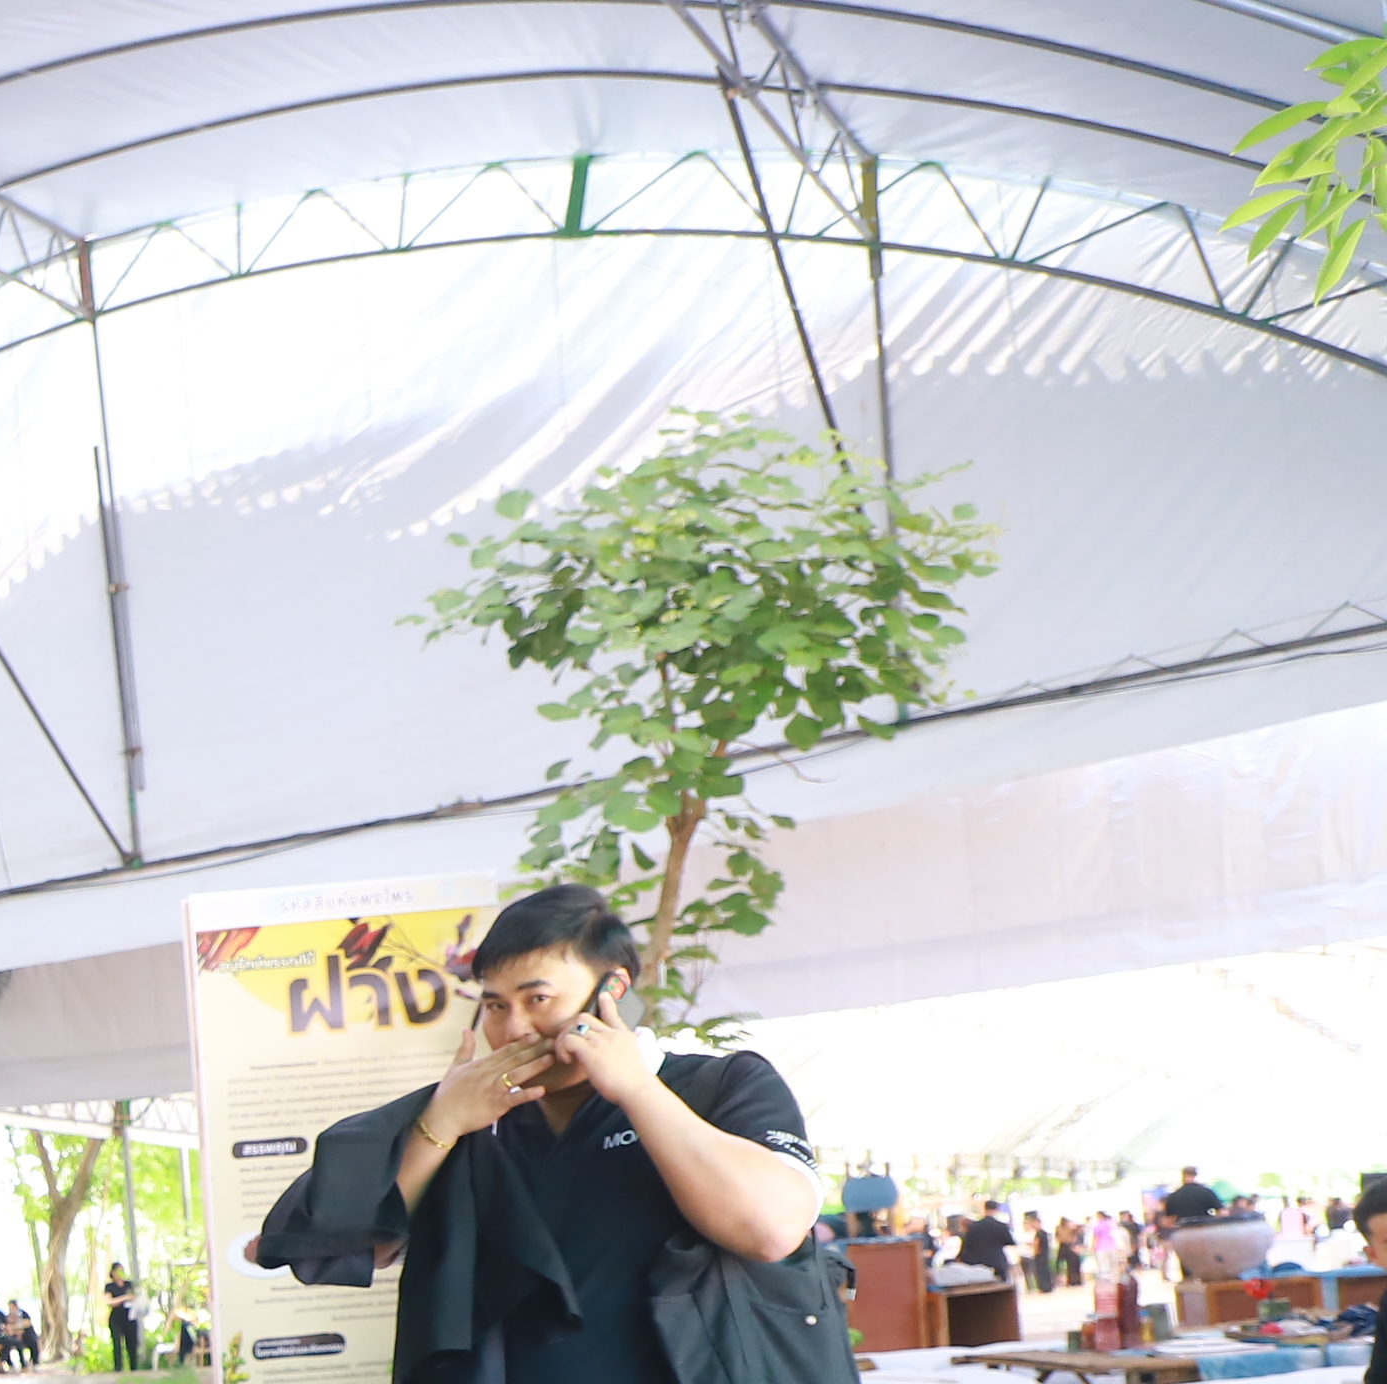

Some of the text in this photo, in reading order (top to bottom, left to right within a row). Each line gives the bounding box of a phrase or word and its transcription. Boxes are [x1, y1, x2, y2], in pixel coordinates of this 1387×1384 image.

[289, 953, 449, 1033] ฝาง
[242, 1141, 297, 1156] สรรพคุณ
